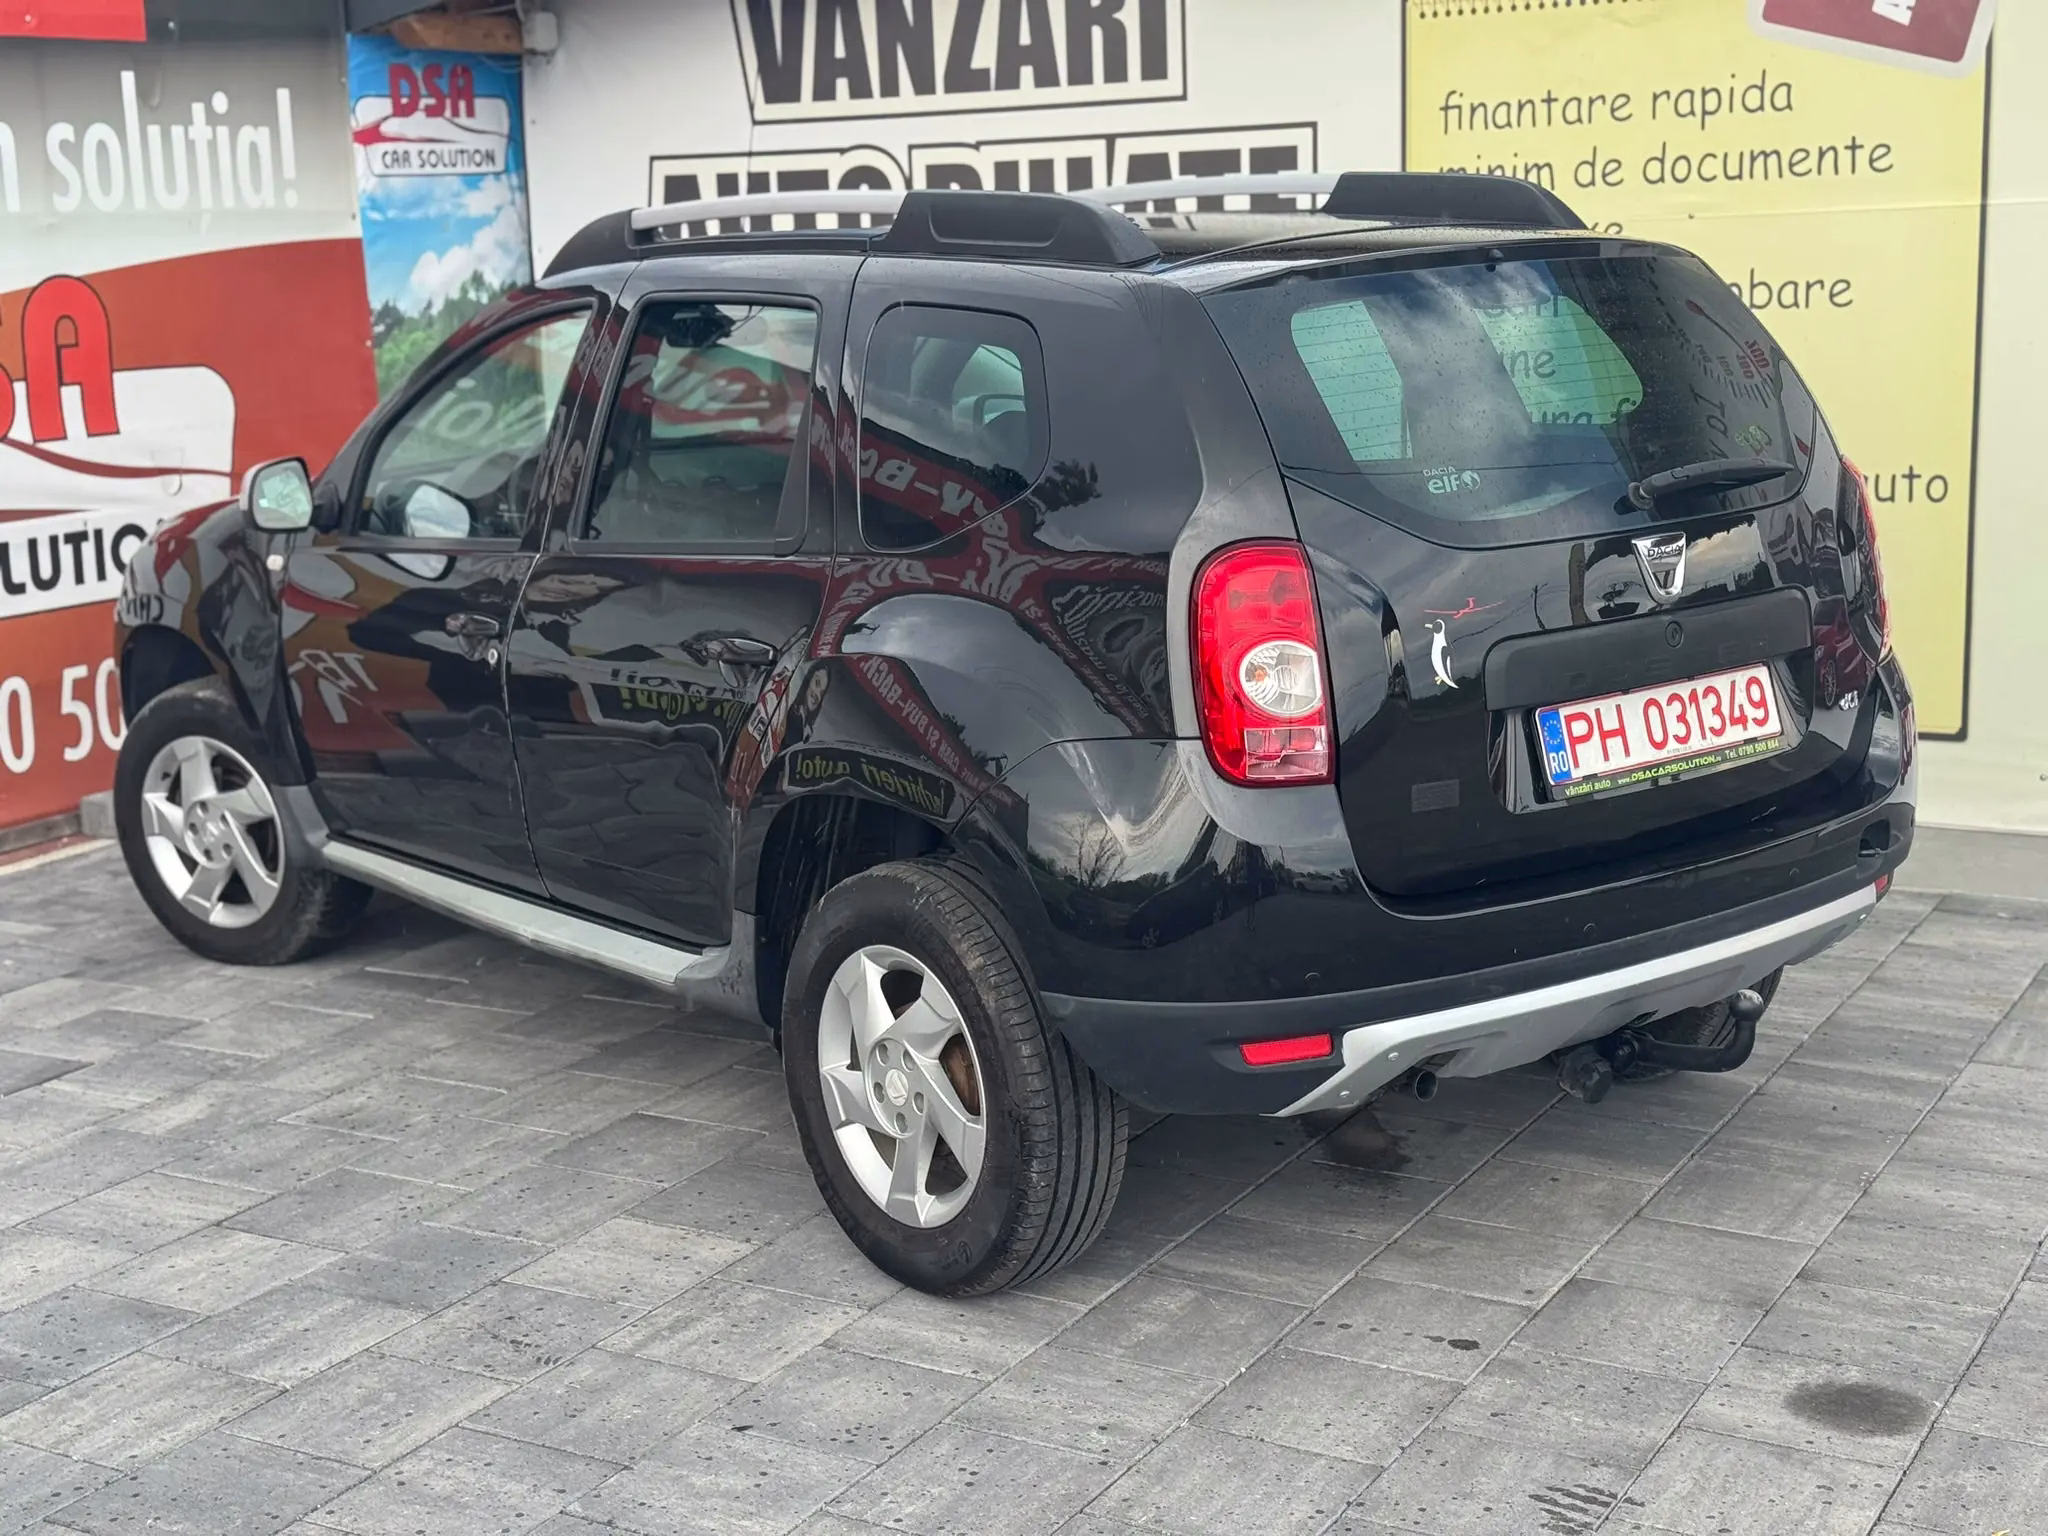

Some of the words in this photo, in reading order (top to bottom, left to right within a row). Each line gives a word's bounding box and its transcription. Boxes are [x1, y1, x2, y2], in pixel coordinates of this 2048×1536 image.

[747, 0, 1168, 104] VANZARI
[388, 63, 476, 118] DSA
[1440, 90, 1633, 134] finantare
[1652, 69, 1794, 130] rapida
[46, 70, 298, 212] solutia!
[381, 150, 412, 168] CAR
[417, 149, 497, 169] SOLUTION
[1574, 146, 1625, 189] de
[1642, 136, 1894, 185] documente
[0, 274, 121, 444] A
[1423, 466, 1457, 477] DACIA
[1427, 474, 1461, 494] elf
[1863, 465, 1950, 504] uto
[0, 522, 149, 596] LUTIO
[1646, 544, 1684, 558] DACIA
[1563, 703, 1631, 770] PH
[1643, 675, 1770, 751] 031349
[1551, 750, 1569, 775] RO
[1594, 779, 1612, 790] auto
